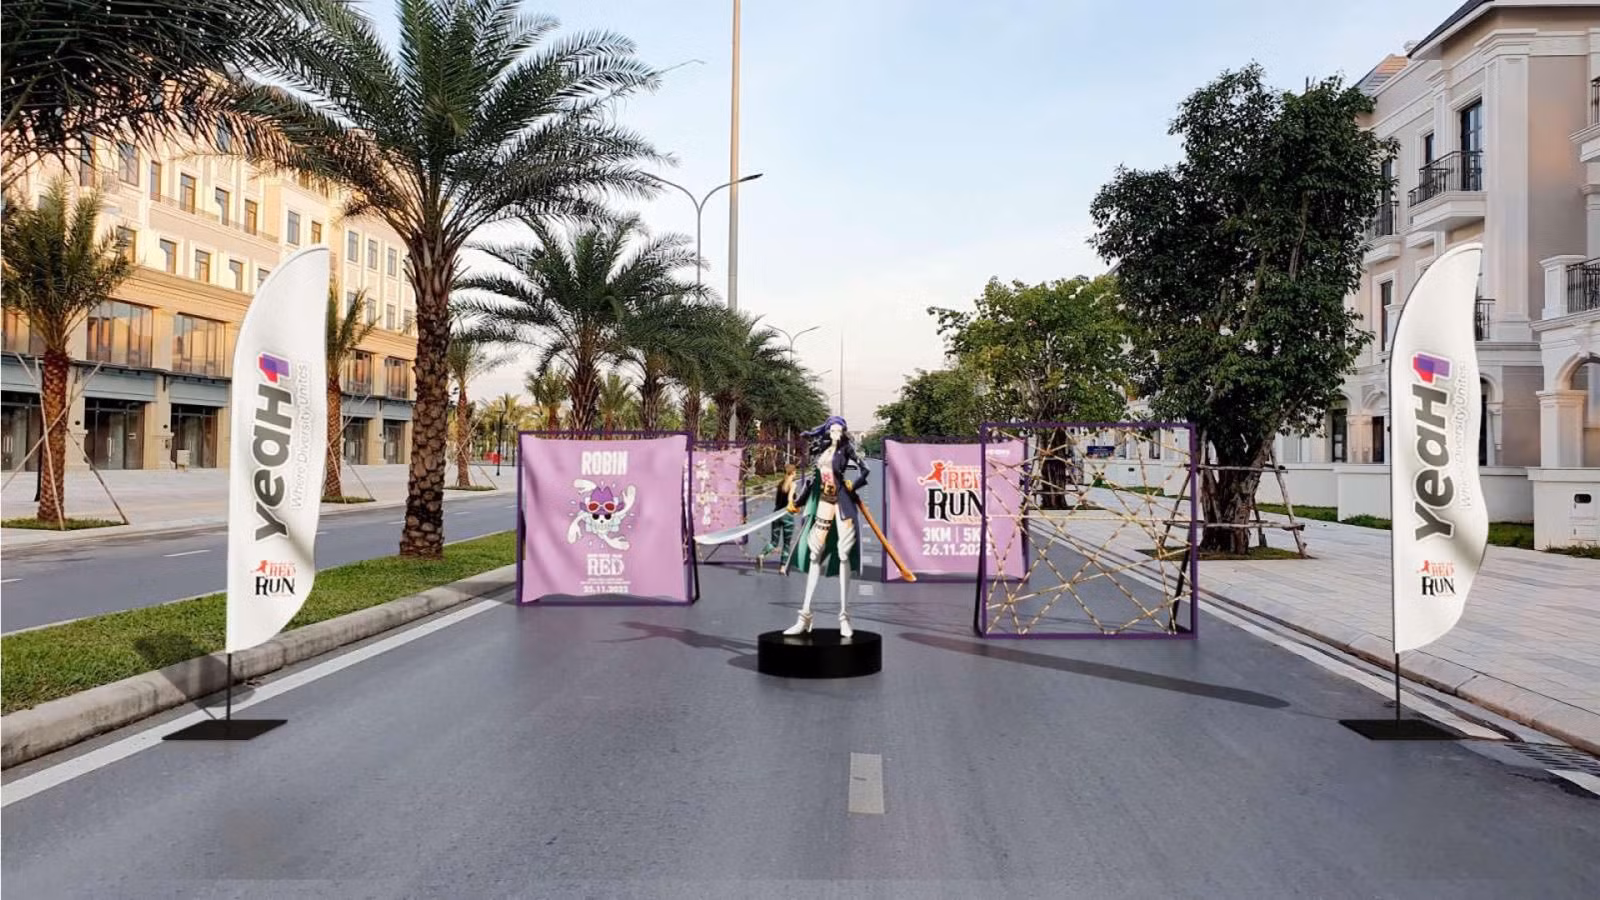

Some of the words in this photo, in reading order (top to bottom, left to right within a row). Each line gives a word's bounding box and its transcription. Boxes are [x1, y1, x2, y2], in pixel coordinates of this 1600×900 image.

[297, 364, 310, 406] Unites
[296, 409, 313, 463] Diversity
[581, 452, 628, 475] ROBIN
[292, 464, 306, 509] Where
[928, 488, 990, 522] RUN
[922, 527, 951, 542] 3KM
[963, 527, 992, 542] 5K
[922, 543, 992, 556] 26.11.2022
[588, 560, 624, 576] RED
[255, 576, 296, 597] RUN
[1421, 576, 1457, 597] RUN
